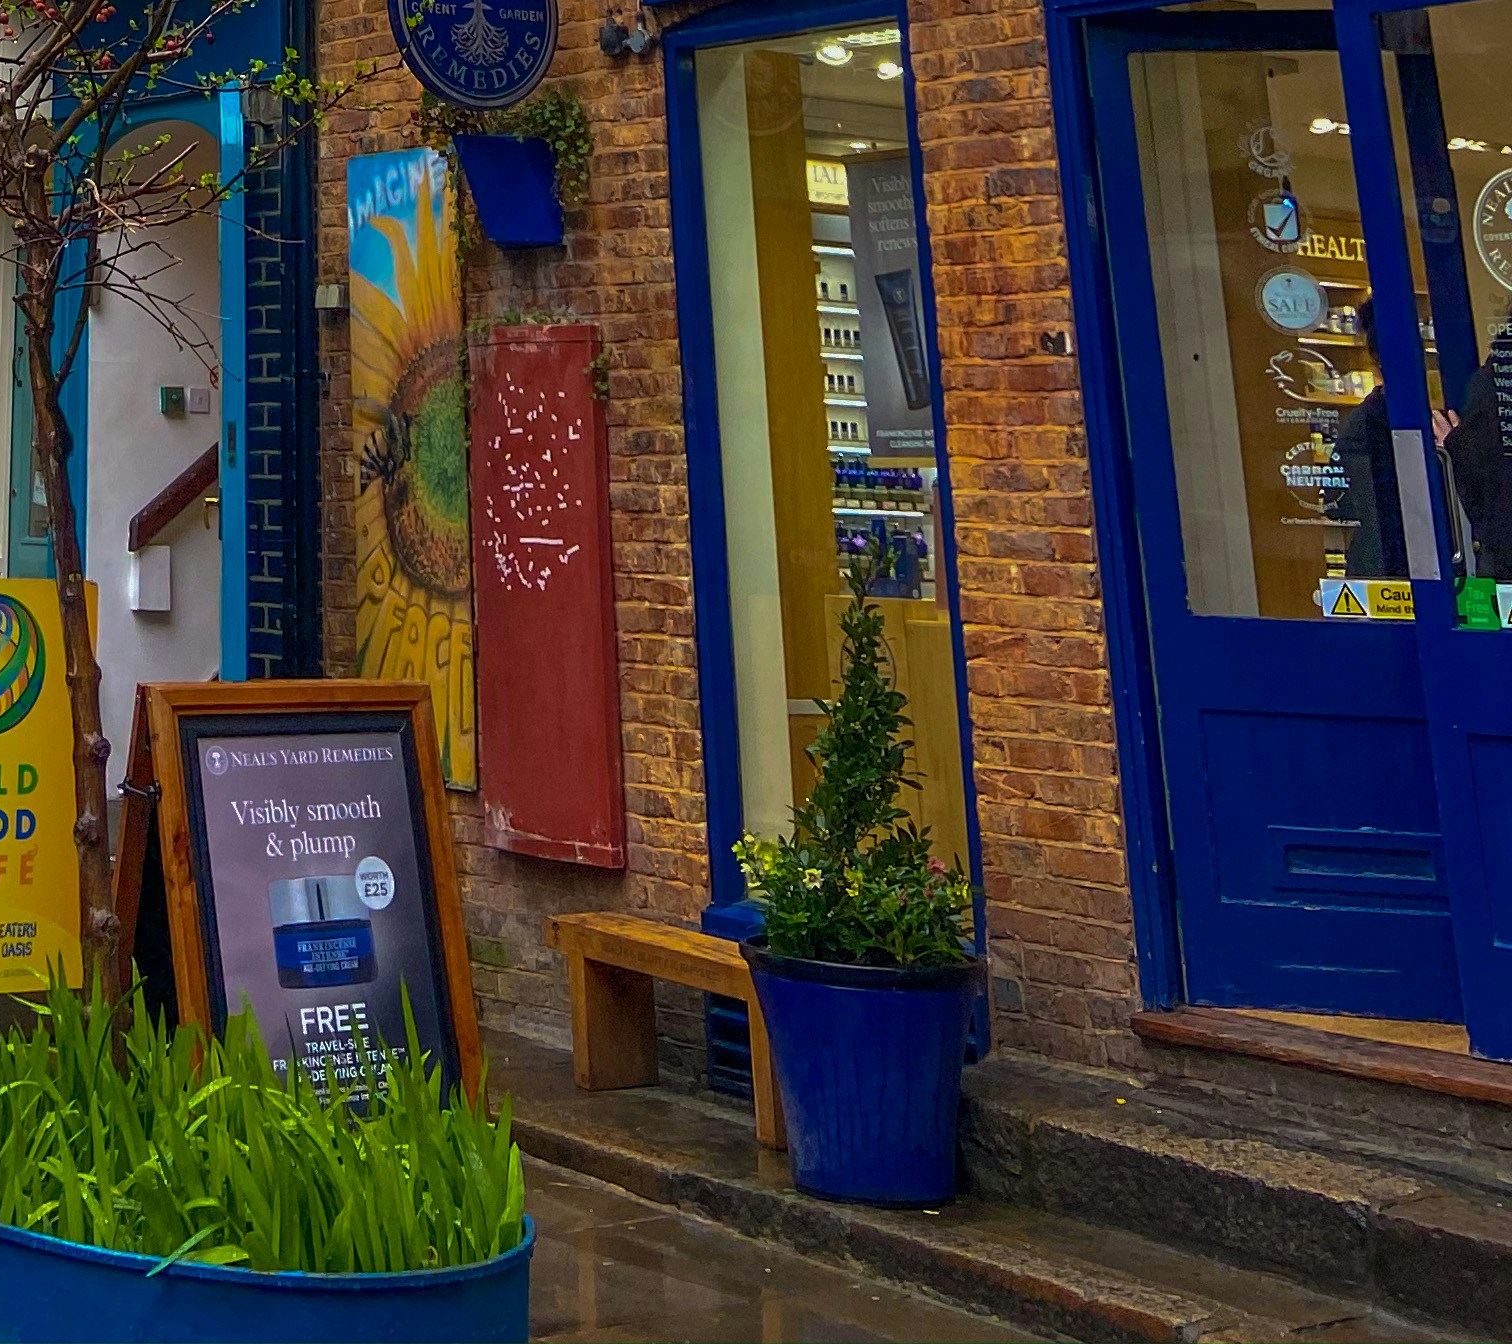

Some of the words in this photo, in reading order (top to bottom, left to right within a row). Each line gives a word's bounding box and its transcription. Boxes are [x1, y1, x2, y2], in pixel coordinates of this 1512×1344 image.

[499, 8, 545, 23] GARDEN
[417, 31, 541, 91] REMEDIES
[1296, 233, 1366, 262] HEALT
[1280, 464, 1345, 477] CARBON
[1380, 587, 1411, 602] Cau
[1467, 587, 1485, 600] Tax
[230, 750, 279, 768] NEAL'S
[279, 748, 319, 765] YARD
[321, 746, 394, 764] REMEDIES
[230, 798, 300, 828] Visibly
[306, 794, 382, 822] smooth
[266, 832, 284, 857] &
[290, 830, 356, 862] plump
[359, 871, 389, 881] WORTH
[364, 882, 389, 898] £25
[1, 941, 33, 958] OASIS
[300, 1002, 369, 1035] FREE
[304, 1037, 370, 1054] TRAVEL-SIE
